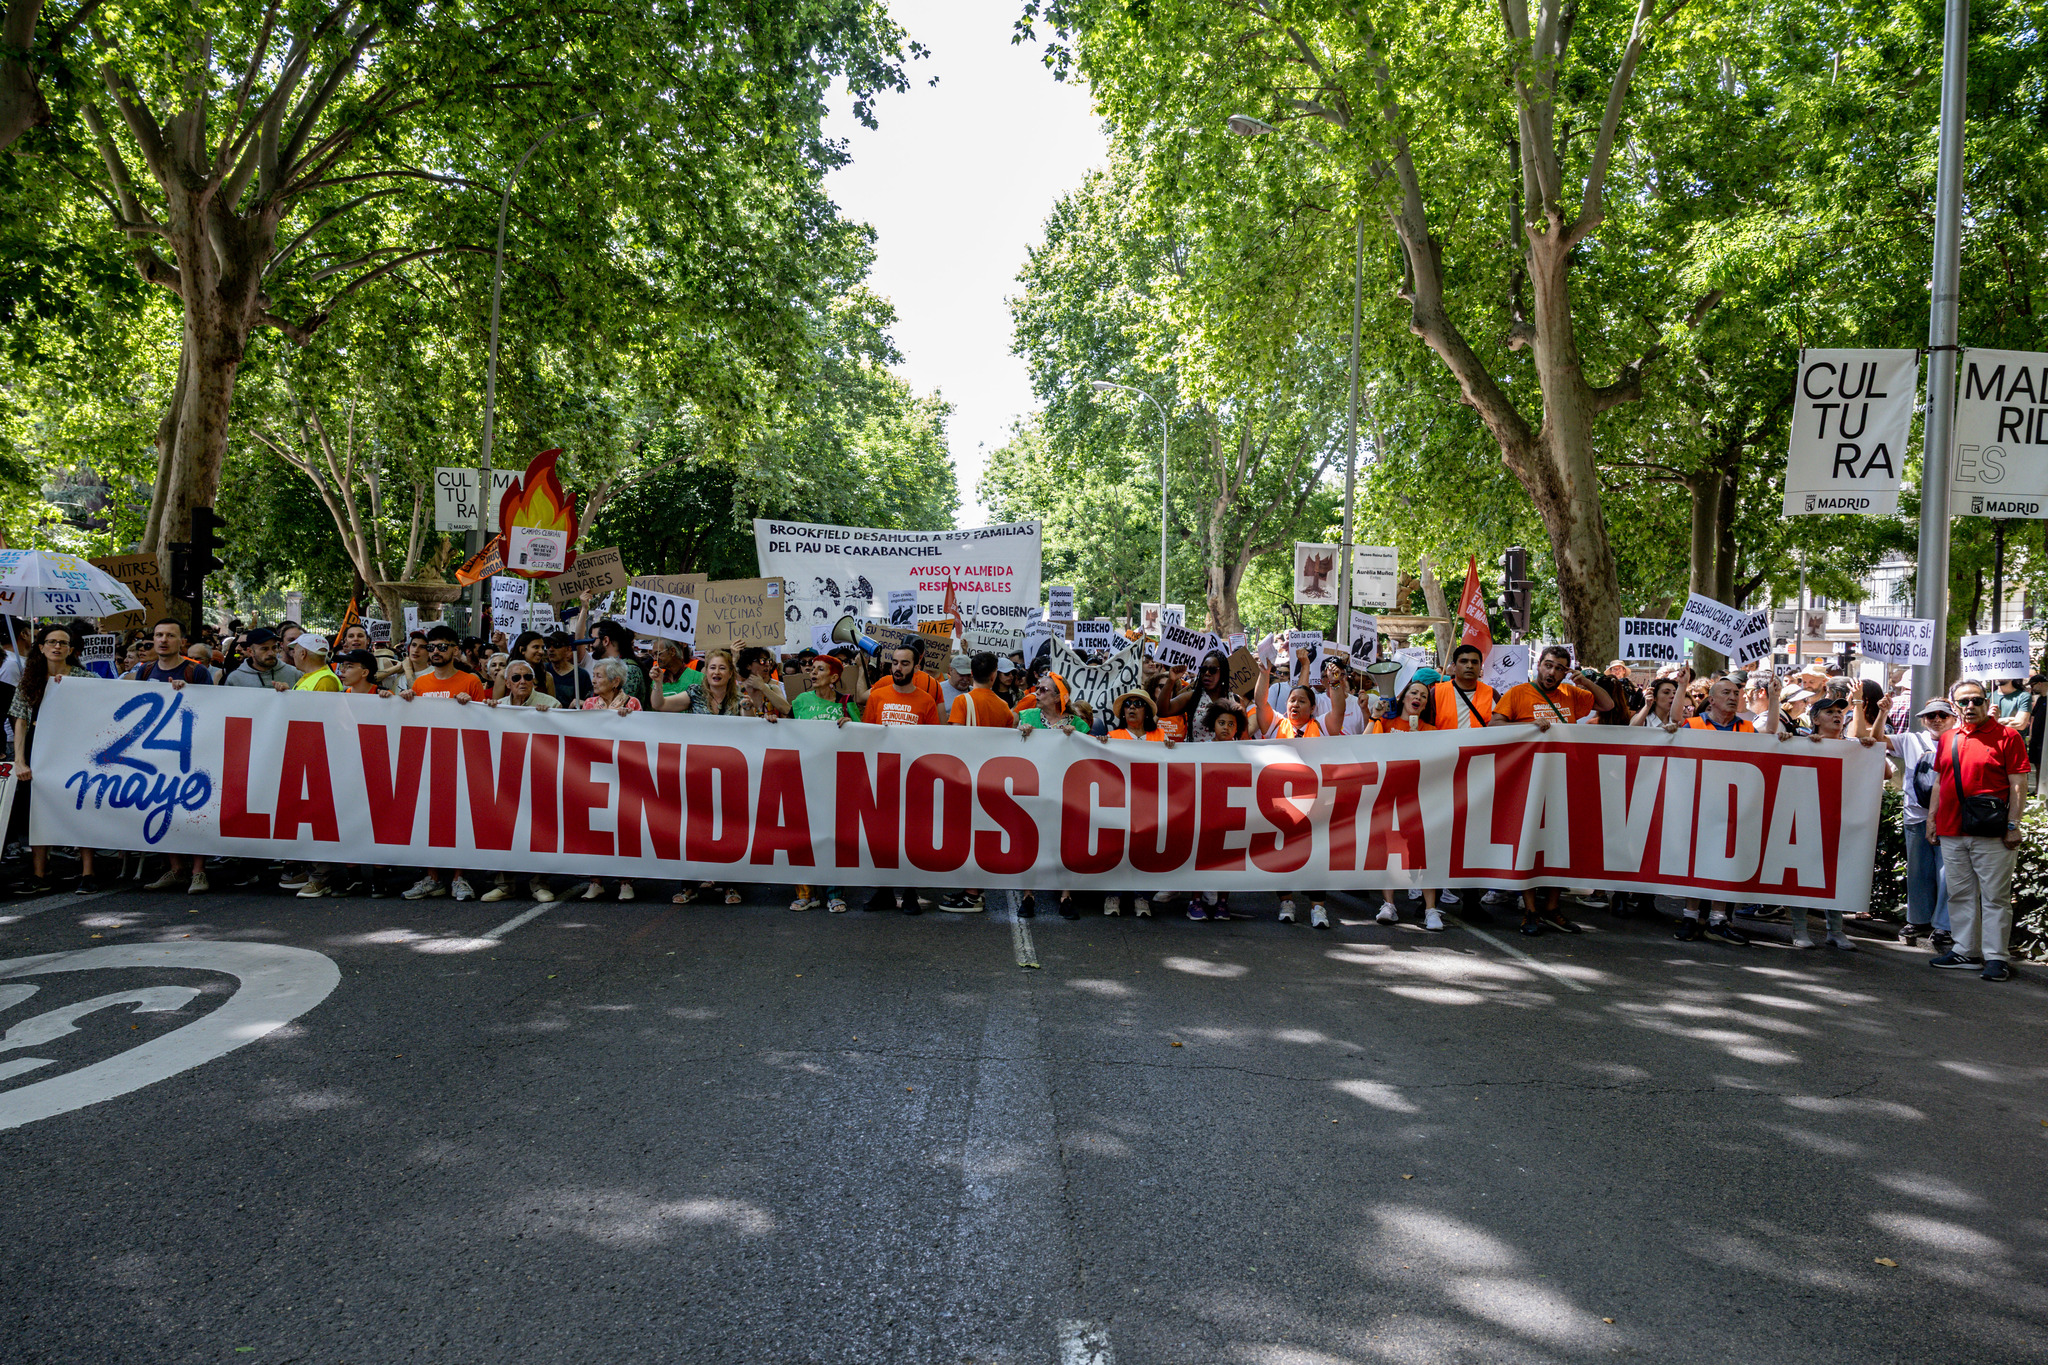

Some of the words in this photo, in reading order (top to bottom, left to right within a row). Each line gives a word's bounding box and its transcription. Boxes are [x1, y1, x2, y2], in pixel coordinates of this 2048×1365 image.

[1802, 362, 1888, 400] CUL
[1812, 403, 1869, 440] TU
[1832, 443, 1895, 479] RA
[1955, 444, 2007, 484] ES
[437, 472, 471, 487] CUL
[444, 488, 467, 502] TU
[457, 504, 478, 518] RA
[1818, 498, 1870, 511] MADRID
[1986, 501, 2040, 515] MADRID
[770, 524, 850, 540] BROOKFIELD
[854, 531, 929, 543] DESAHUCIA
[945, 531, 970, 540] 859
[974, 525, 1034, 540] FAMILIAS
[769, 541, 791, 553] DEL
[795, 542, 821, 553] PAU
[825, 544, 840, 554] DE
[843, 545, 942, 557] CARABANCHEL
[576, 552, 619, 571] RENTISTAS
[577, 570, 590, 578] DEL
[909, 566, 951, 576] AYUSO
[953, 566, 961, 576] Y
[965, 566, 1014, 576] ALMEIDA
[492, 580, 526, 595] Justicia!
[558, 572, 613, 596] HENARES
[919, 581, 1012, 593] RESPONSABLES
[714, 606, 762, 620] VECINAS
[1686, 600, 1733, 629] DESAHUCIAR,
[707, 624, 721, 635] NO
[725, 621, 779, 641] TURISTAS
[865, 626, 877, 634] EN
[1077, 622, 1110, 633] DERECHO
[1679, 616, 1685, 629] A
[1685, 618, 1714, 639] BANCOS
[1712, 630, 1720, 642] &
[1860, 622, 1917, 640] DESAHUCIAR,
[1920, 623, 1931, 638] SÍ:
[977, 635, 1016, 650] LUCHA!!
[1078, 637, 1085, 648] A
[1085, 638, 1110, 648] TECHO.
[1166, 627, 1206, 651] DERECHO
[1306, 632, 1322, 640] crisis,
[1627, 643, 1635, 658] A
[1638, 643, 1678, 660] TECHO.
[1739, 647, 1749, 663] A
[1862, 639, 1867, 650] A
[1867, 640, 1902, 656] BANCOS
[1903, 643, 1909, 656] &
[1912, 644, 1928, 657] Cía.
[1963, 647, 1986, 657] Buitres
[1987, 648, 1991, 657] y
[1992, 644, 2024, 657] gaviotas,
[1160, 647, 1167, 661] A
[1169, 650, 1197, 671] TECHO.
[1969, 662, 1983, 671] fondo
[1984, 662, 1993, 670] nos
[1994, 659, 2024, 671] explotan.
[883, 703, 912, 712] SINDICATO
[95, 692, 193, 775] 24
[65, 771, 212, 844] mayo
[219, 717, 340, 843] LA
[358, 724, 816, 867] VIVIENDA
[835, 751, 1040, 874] NOS
[1060, 759, 1427, 875] CUESTA
[1462, 752, 1570, 871] LA
[1598, 754, 1826, 889] VIDA
